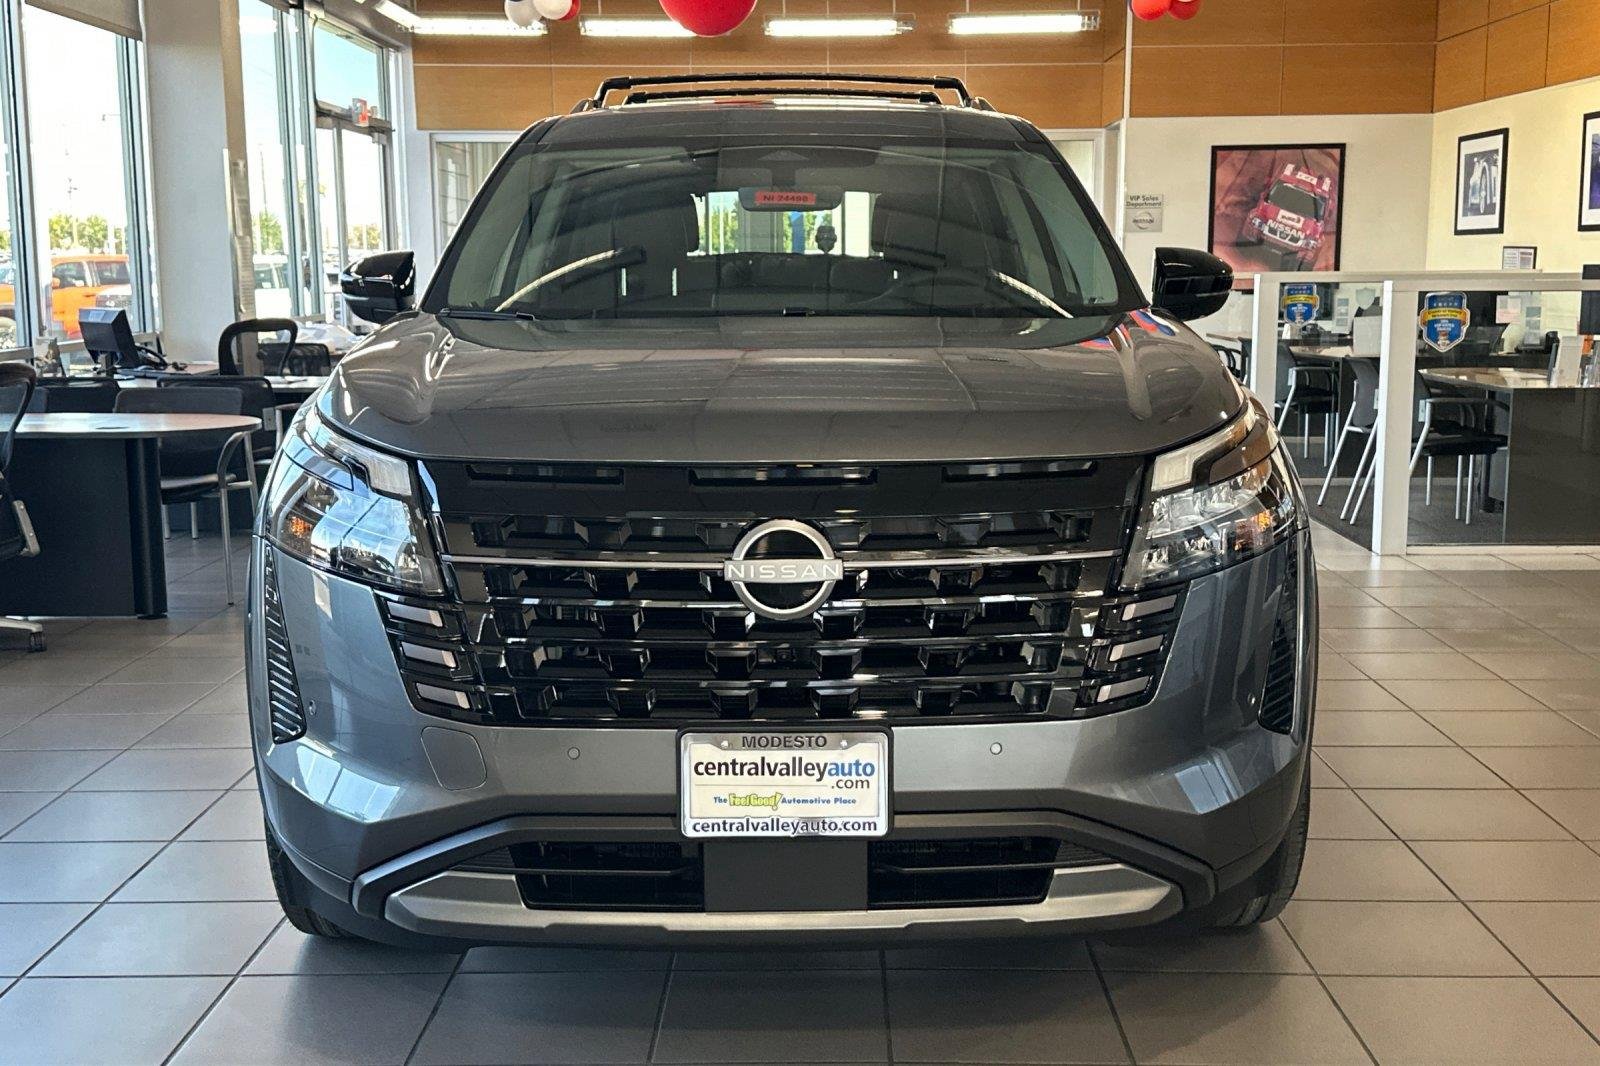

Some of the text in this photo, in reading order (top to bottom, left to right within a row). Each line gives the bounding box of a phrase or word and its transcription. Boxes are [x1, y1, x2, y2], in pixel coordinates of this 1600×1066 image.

[1266, 219, 1306, 239] NISSAN
[728, 564, 839, 579] NISSAN
[741, 735, 827, 749] MODESTO
[693, 757, 876, 782] centralvalleyauto
[713, 796, 728, 804] The
[781, 797, 831, 805] Automotive
[833, 797, 857, 805] Place
[692, 818, 878, 835] centralvalleyauto.com
